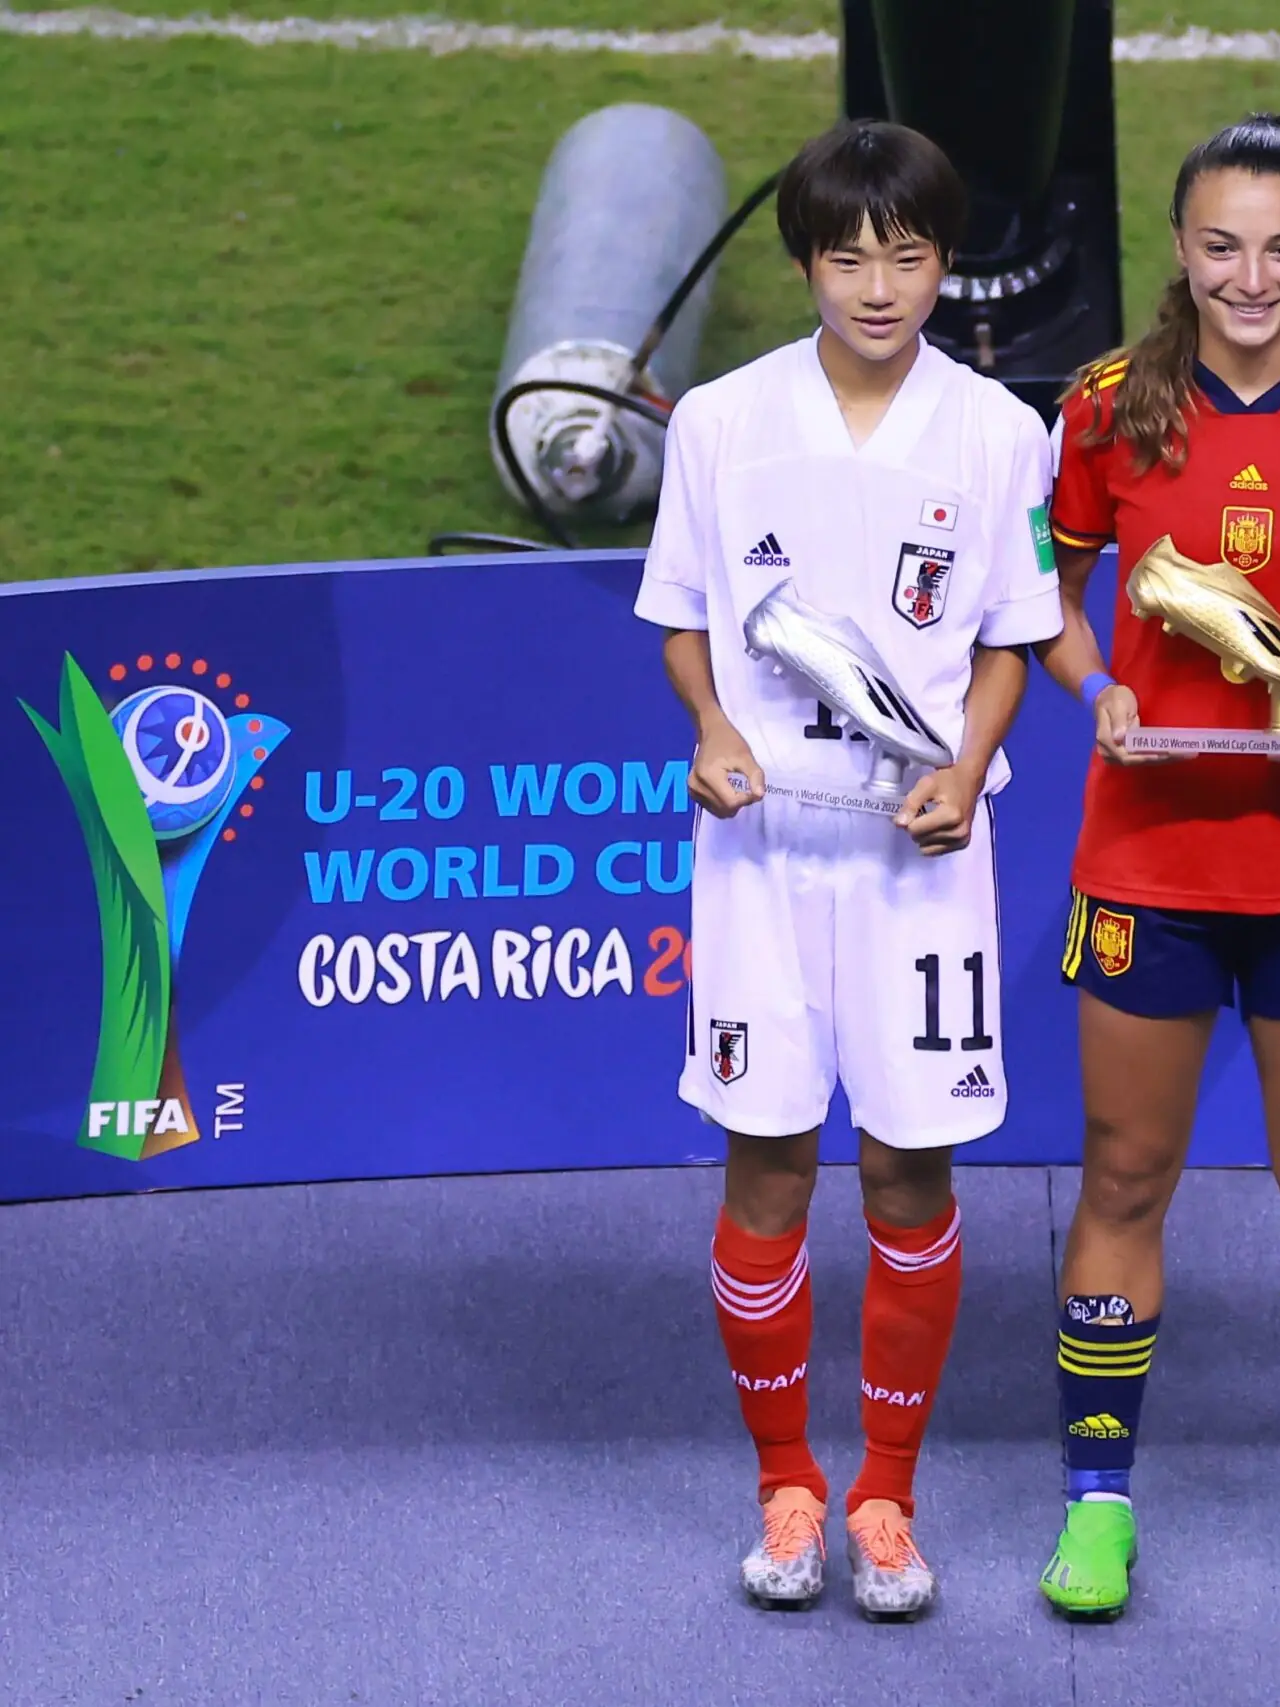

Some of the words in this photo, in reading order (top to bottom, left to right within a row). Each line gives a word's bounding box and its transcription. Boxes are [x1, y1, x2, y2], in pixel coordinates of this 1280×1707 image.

[1229, 480, 1268, 491] adidas
[744, 553, 790, 567] adidas
[916, 547, 948, 559] JAPAN
[907, 601, 934, 617] JFA
[1133, 737, 1149, 748] FIFA
[1207, 740, 1230, 750] World
[1231, 740, 1247, 752] Cup
[1248, 740, 1270, 751] Costa
[304, 765, 465, 824] U-20
[800, 789, 823, 802] World
[824, 792, 840, 805] Cup
[841, 795, 862, 807] Costa
[864, 798, 880, 810] Rica
[304, 844, 575, 903] WORLD
[299, 929, 481, 1007] COSTA
[913, 951, 993, 1051] 11
[950, 1085, 995, 1098] adidas
[88, 1098, 189, 1138] FIFA
[215, 1083, 245, 1138] TM
[1069, 1423, 1130, 1439] adidas
